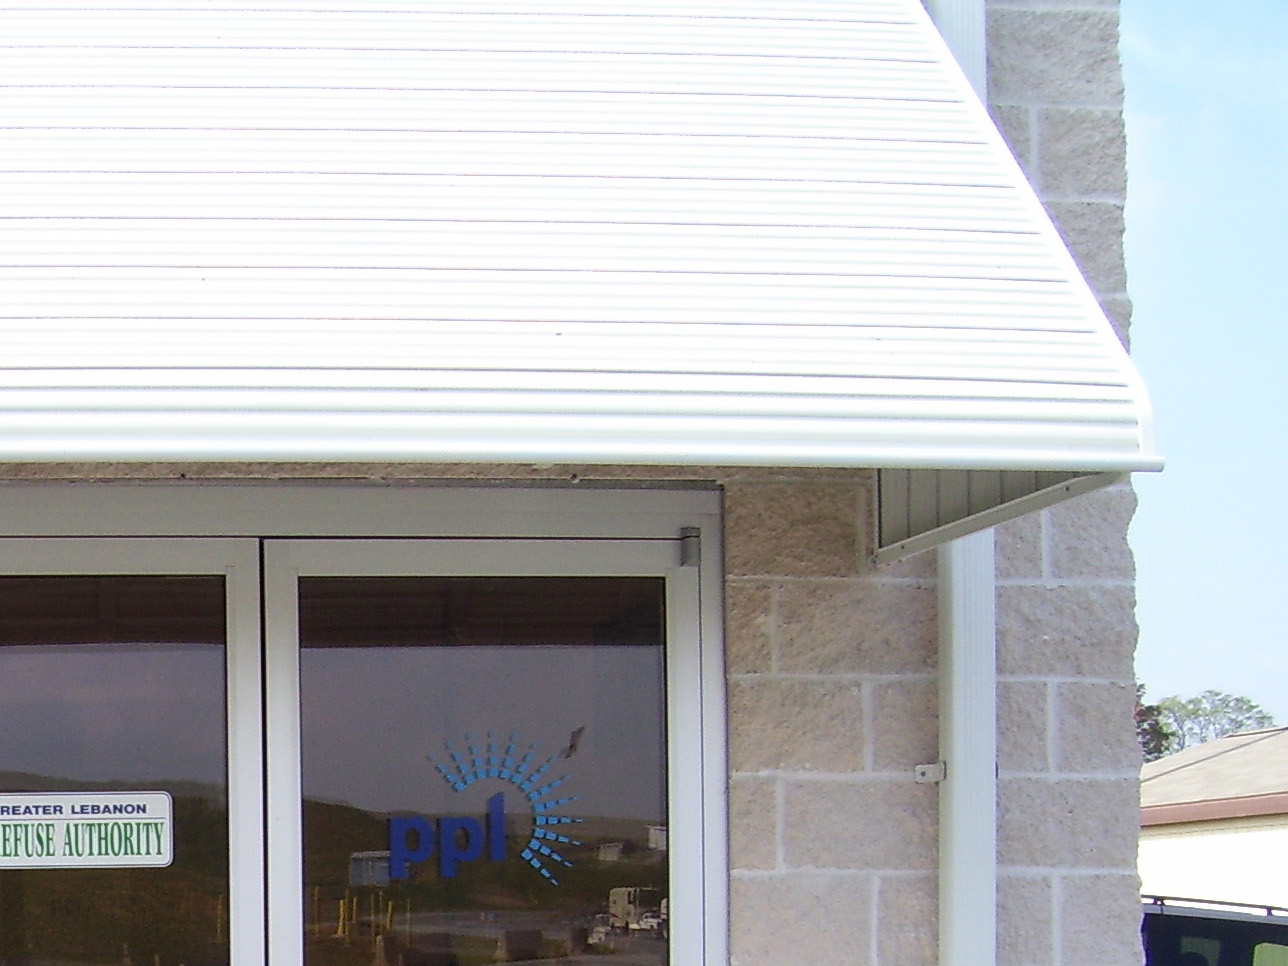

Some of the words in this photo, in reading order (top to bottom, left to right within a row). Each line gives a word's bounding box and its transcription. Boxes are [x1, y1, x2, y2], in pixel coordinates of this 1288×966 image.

[71, 804, 147, 815] LEBANON
[62, 822, 165, 857] AUTHORITY
[388, 792, 509, 879] ppl
